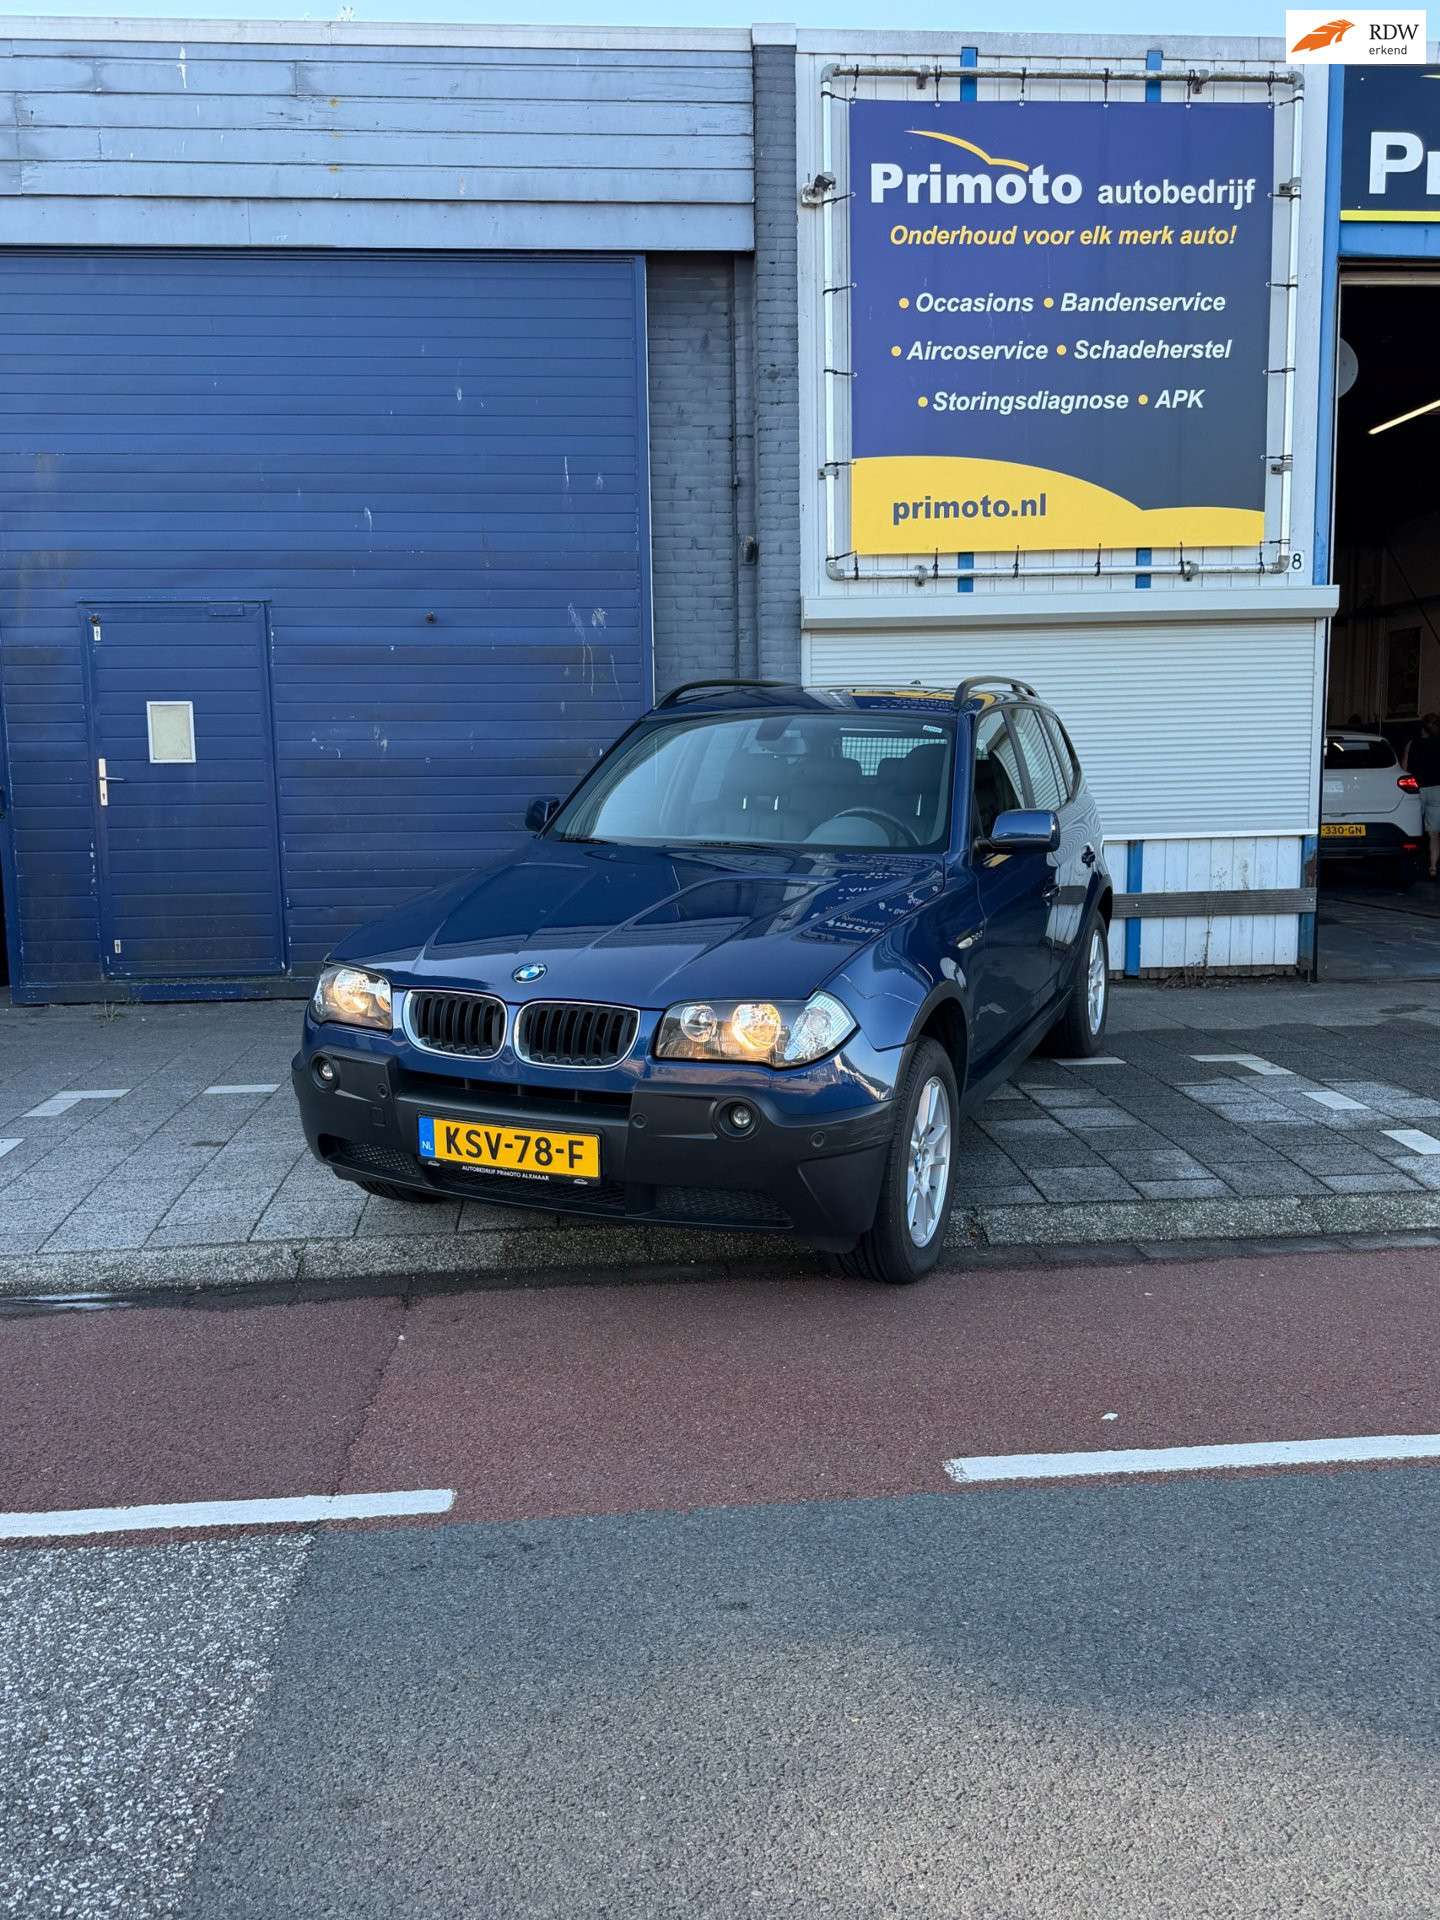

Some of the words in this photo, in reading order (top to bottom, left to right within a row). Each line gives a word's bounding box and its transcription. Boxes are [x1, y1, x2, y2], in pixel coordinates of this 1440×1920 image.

[869, 162, 1083, 205] Primoto
[1097, 178, 1256, 211] autobedrijf
[889, 224, 1018, 246] Onderhoud
[1023, 230, 1074, 245] voor
[1079, 225, 1112, 245] elk
[1118, 225, 1174, 245] merk
[1179, 224, 1238, 245] auto!
[915, 292, 1035, 313] Occasions
[1060, 291, 1226, 312] Bandenservice
[906, 340, 1049, 361] Aircoservice
[1073, 339, 1233, 360] Schadeherstel
[932, 391, 1129, 416] Storingsdiagnose
[1154, 389, 1206, 409] APK
[892, 492, 1047, 526] primoto.nl
[1291, 552, 1302, 570] 8
[421, 1140, 433, 1151] NL
[444, 1125, 585, 1169] KSV-78-F
[496, 1169, 521, 1178] PRIMOTO
